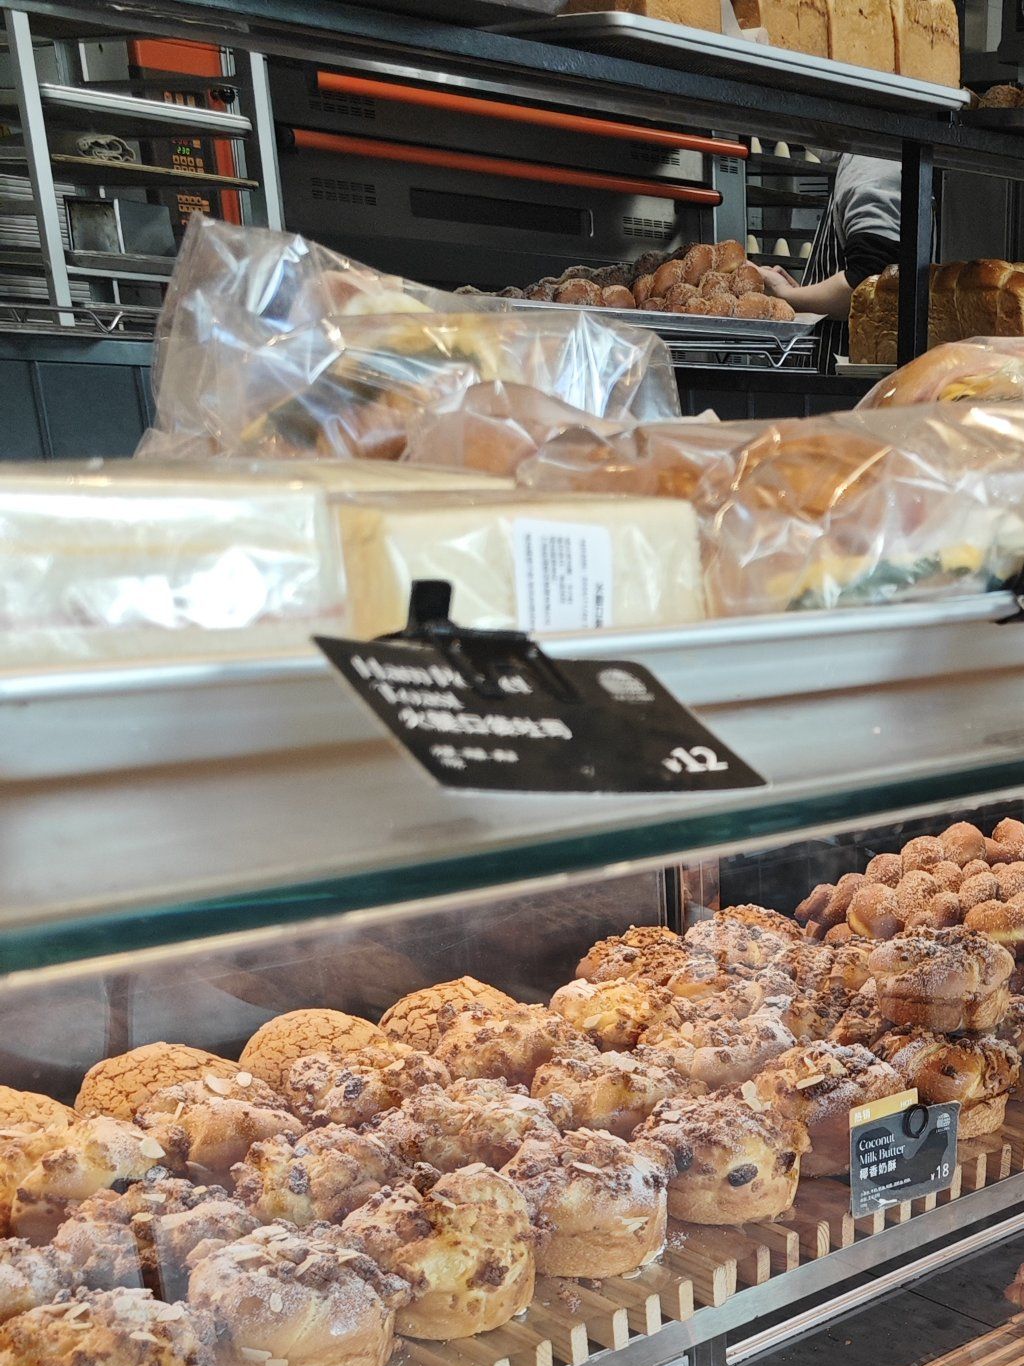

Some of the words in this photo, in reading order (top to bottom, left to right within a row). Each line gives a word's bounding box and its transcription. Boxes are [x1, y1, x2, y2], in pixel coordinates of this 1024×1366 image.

[859, 1133, 896, 1152] Coconut
[859, 1153, 878, 1166] Milk
[878, 1144, 906, 1160] Butter
[859, 1159, 898, 1180] 椰香奶酥
[930, 1163, 950, 1182] ¥18
